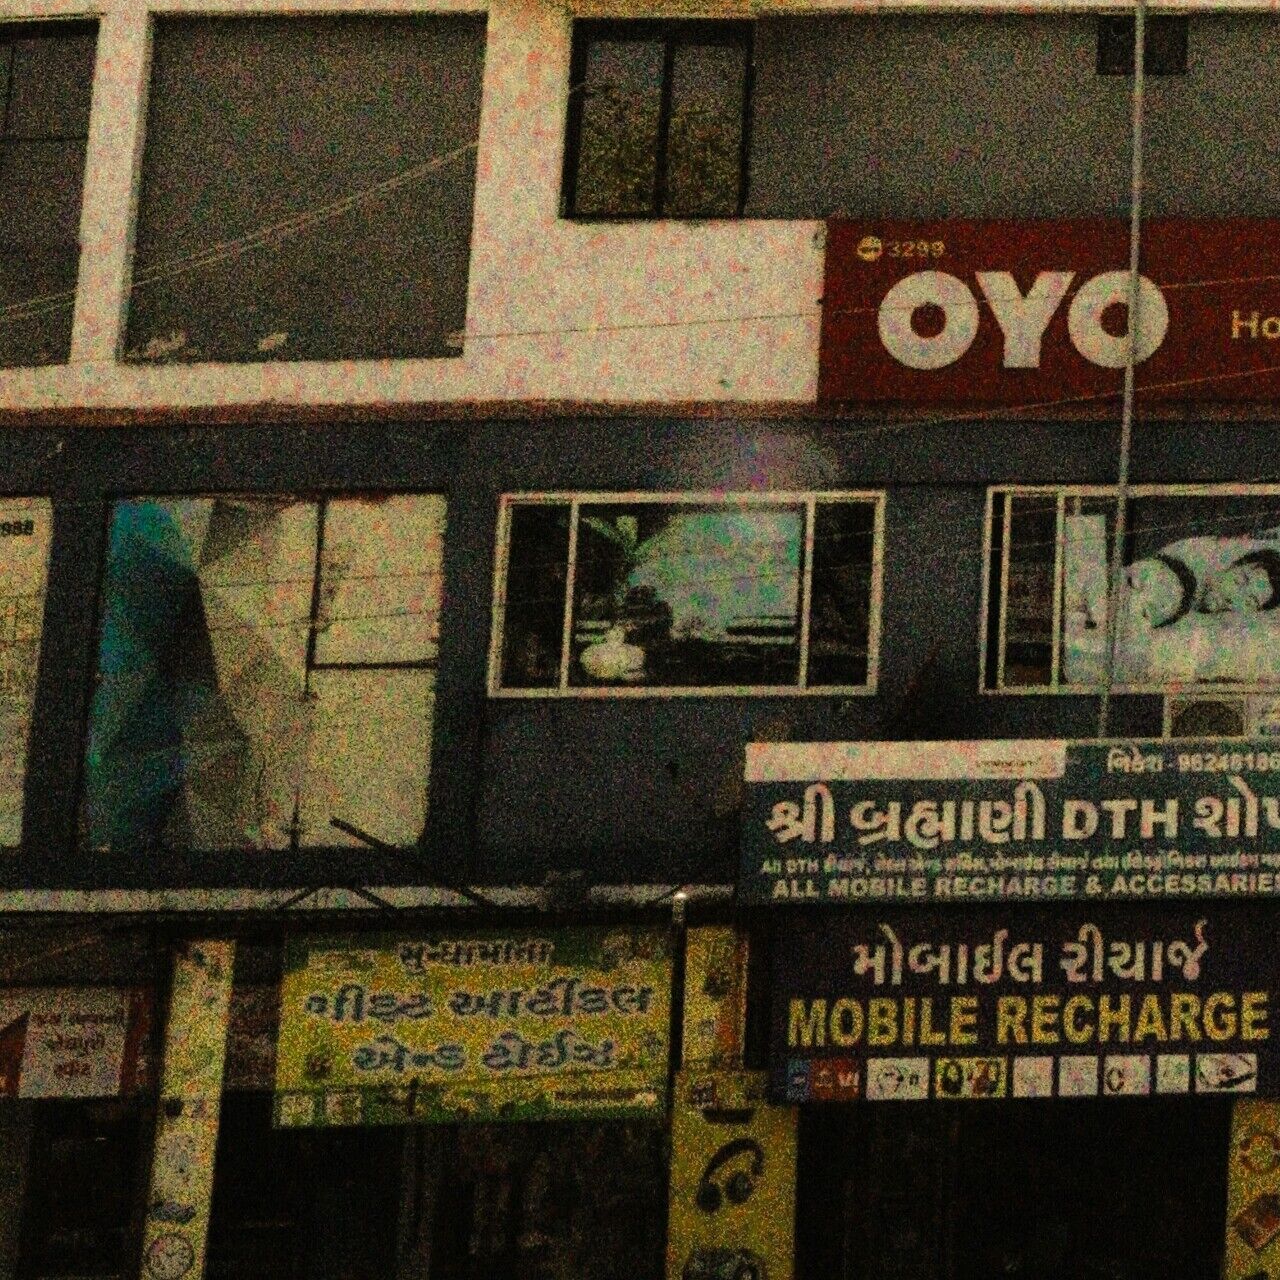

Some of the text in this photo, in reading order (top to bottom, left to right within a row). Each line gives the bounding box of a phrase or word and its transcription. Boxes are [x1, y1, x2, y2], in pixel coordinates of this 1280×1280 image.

[877, 270, 1169, 369] OYO
[766, 783, 835, 843] શ્રી
[1062, 799, 1179, 839] DTH
[771, 879, 820, 899] ALL
[828, 878, 927, 898] MOBILE
[934, 876, 1076, 898] RECHARGE
[1085, 875, 1102, 895] &
[786, 859, 818, 872] DTH
[1059, 920, 1208, 981] રીચાર્જ
[788, 992, 1271, 1048] MOBILE RECHARGE
